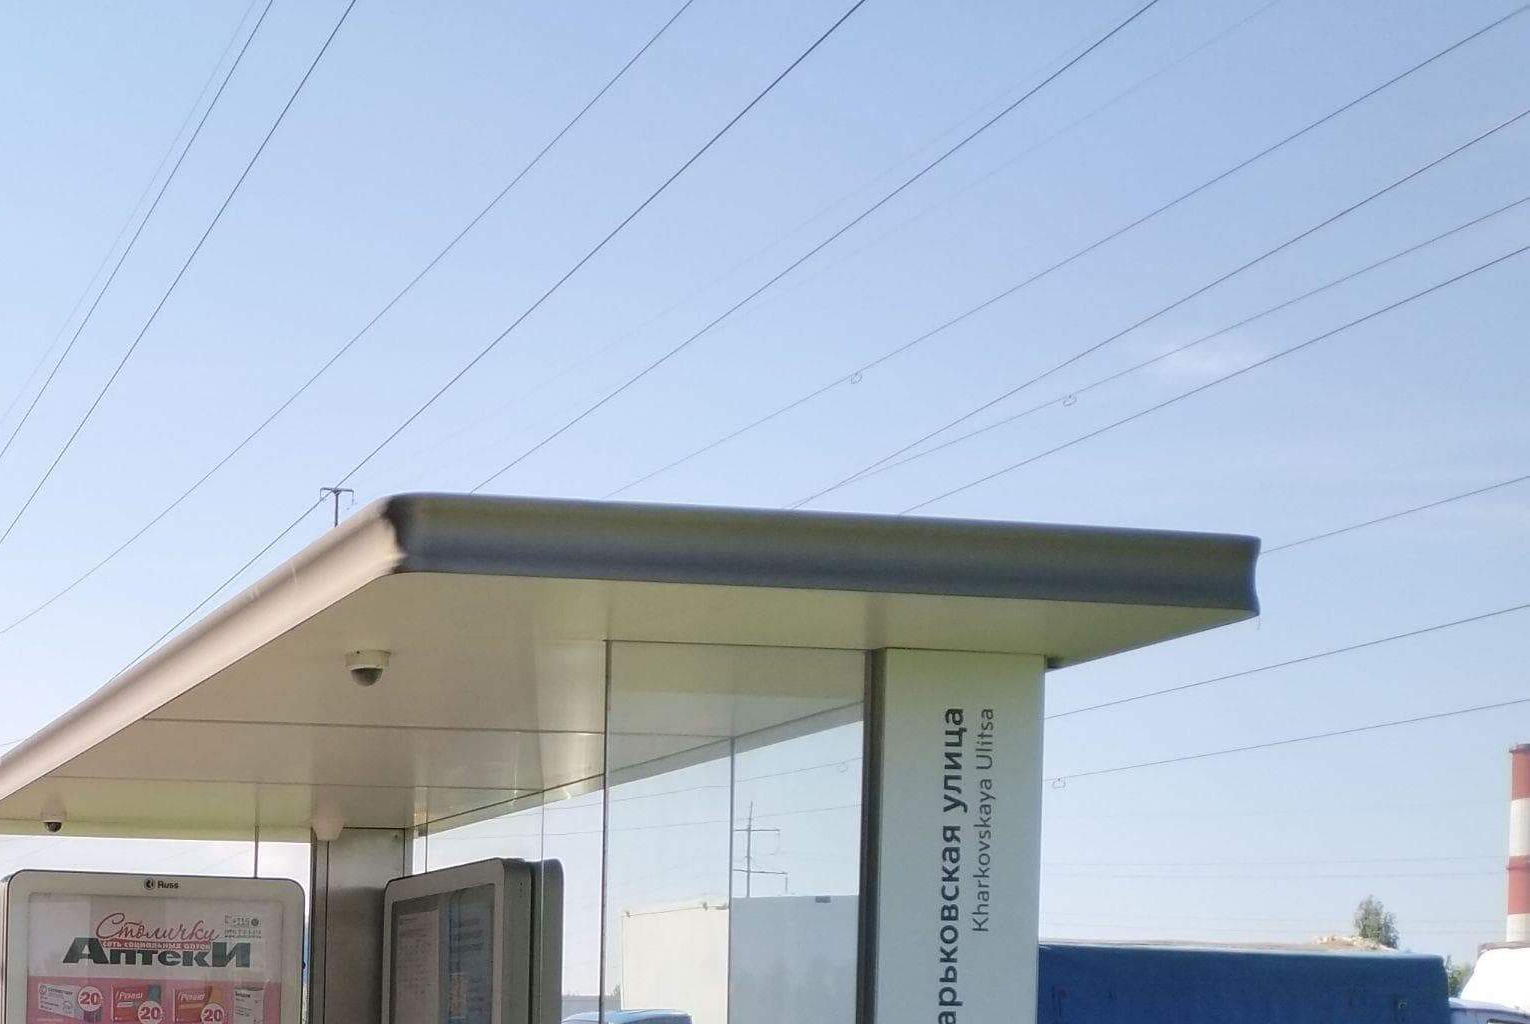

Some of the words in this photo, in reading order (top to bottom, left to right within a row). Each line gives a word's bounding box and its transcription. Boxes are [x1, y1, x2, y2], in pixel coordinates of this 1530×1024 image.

[943, 707, 968, 814] улица
[976, 708, 995, 769] Ulitsa
[157, 880, 179, 889] Russ
[972, 778, 996, 932] Kharkovskaya
[96, 912, 220, 941] Столички
